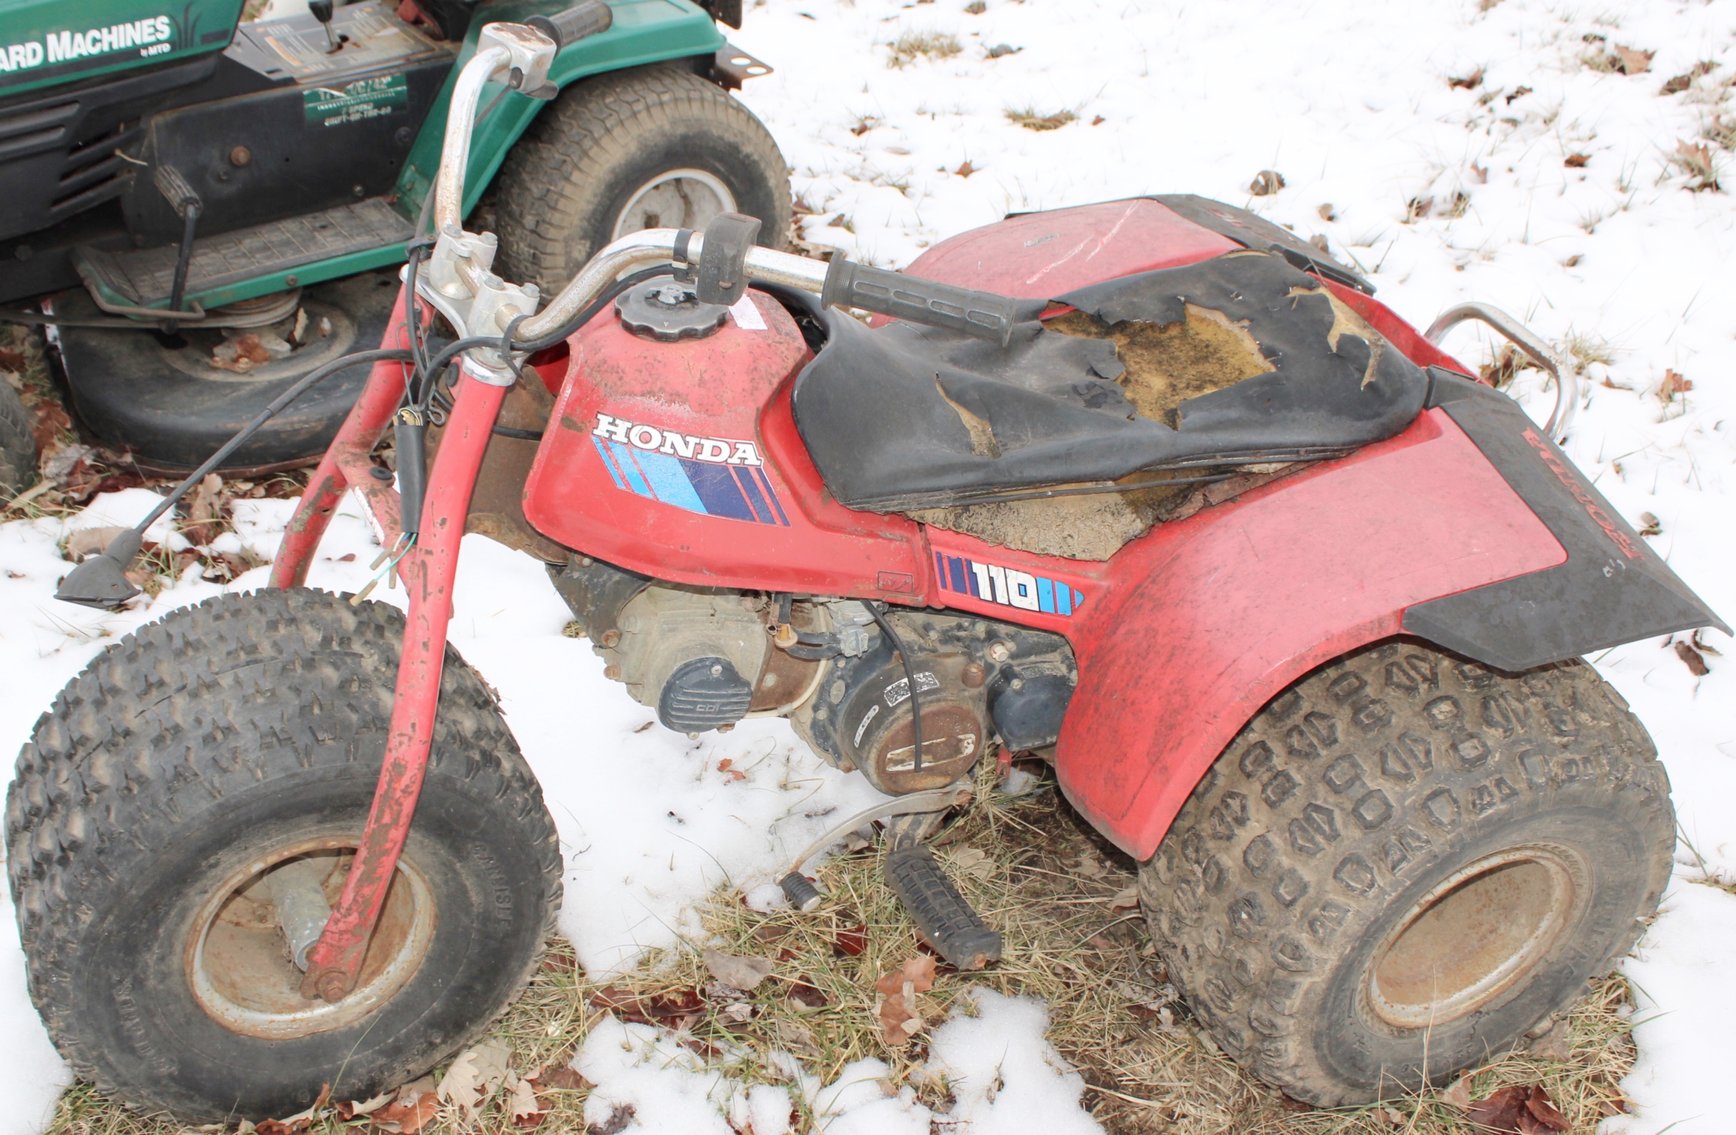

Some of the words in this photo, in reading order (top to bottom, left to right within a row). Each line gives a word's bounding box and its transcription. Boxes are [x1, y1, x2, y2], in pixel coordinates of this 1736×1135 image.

[46, 15, 171, 63] MACHINES
[149, 43, 171, 56] MTD
[592, 411, 763, 467] HONDA
[1521, 427, 1645, 560] HONDA
[971, 561, 1039, 612] 110
[696, 704, 720, 712] CDI
